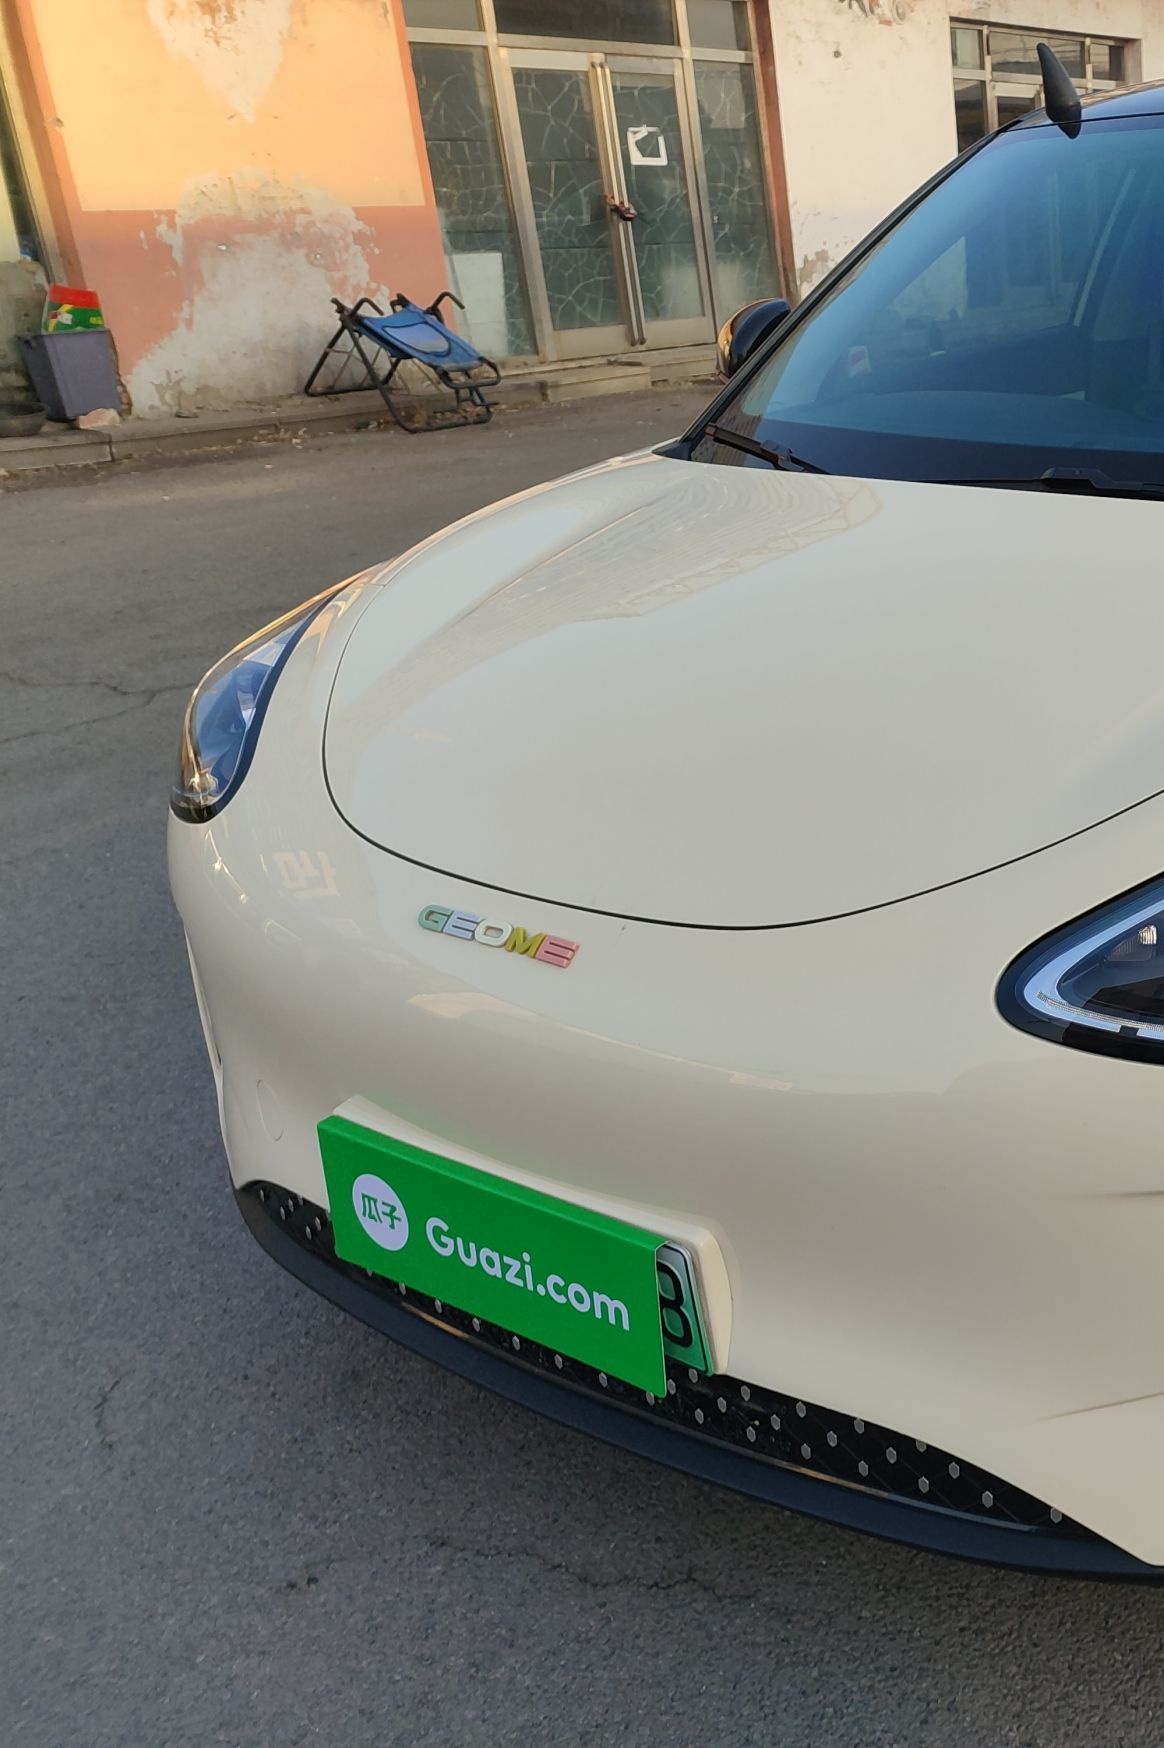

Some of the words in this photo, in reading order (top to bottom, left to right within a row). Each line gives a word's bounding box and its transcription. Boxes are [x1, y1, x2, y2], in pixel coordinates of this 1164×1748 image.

[418, 904, 580, 968] GEOME
[360, 1192, 402, 1230] 瓜子
[425, 1217, 630, 1331] Guazi.com
